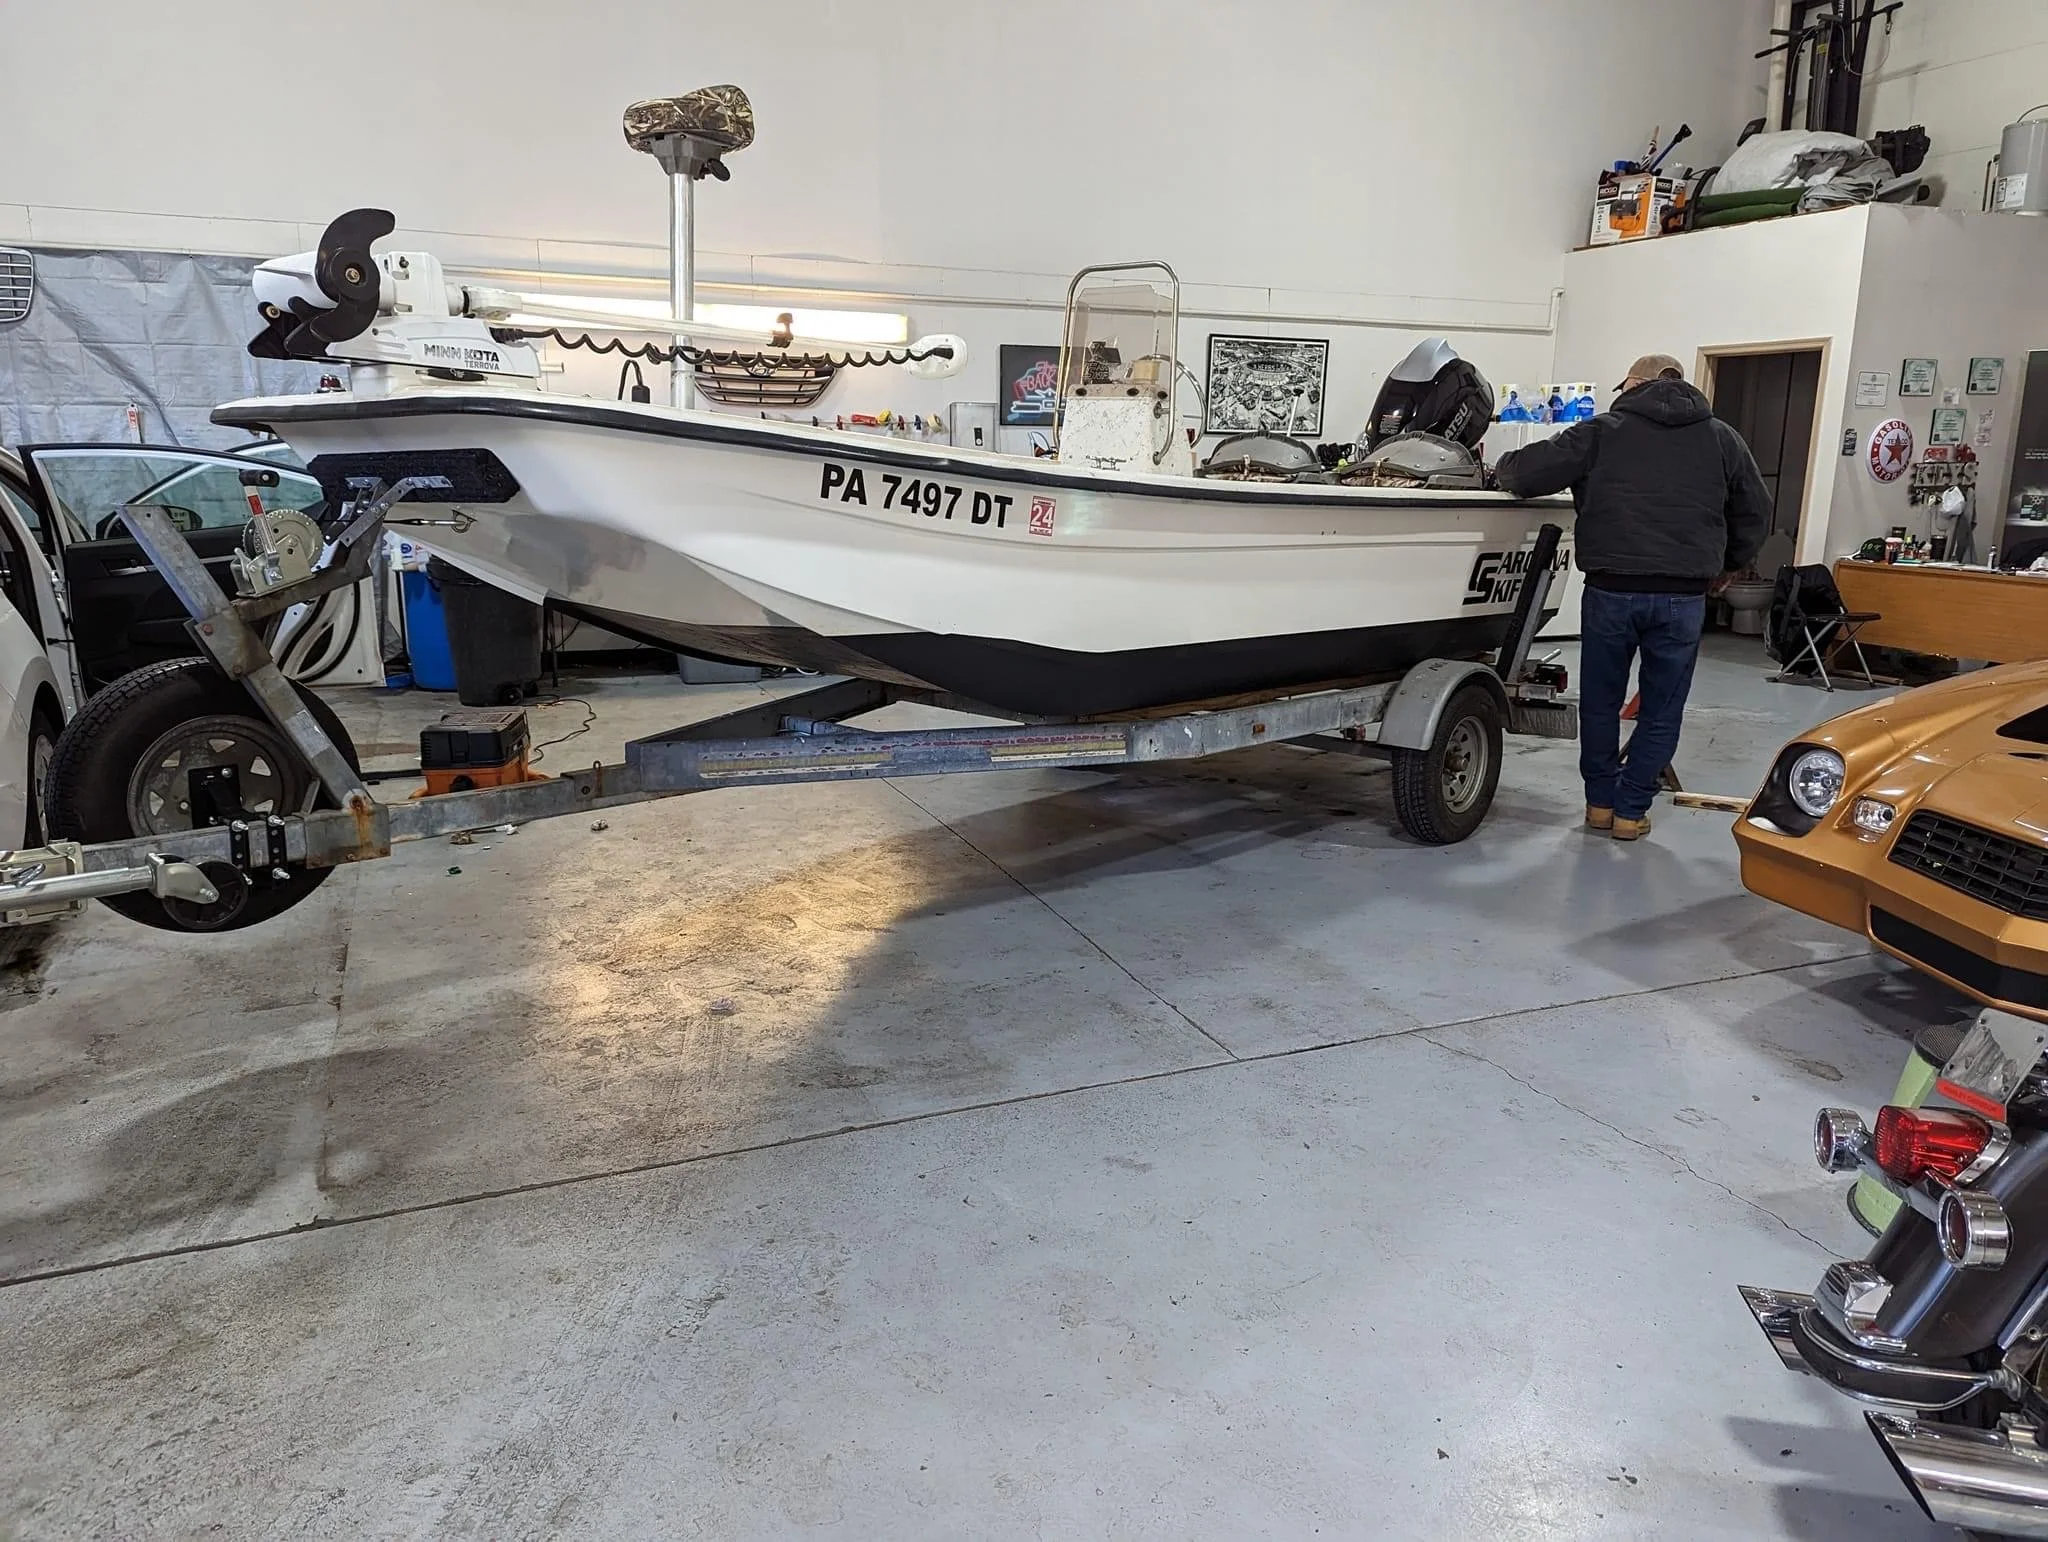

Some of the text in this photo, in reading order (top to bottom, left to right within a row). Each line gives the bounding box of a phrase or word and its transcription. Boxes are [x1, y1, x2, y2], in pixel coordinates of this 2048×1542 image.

[424, 343, 499, 362] MINN KOTA
[464, 360, 500, 370] TERROVA
[1444, 401, 1468, 440] ATSU
[820, 463, 1013, 528] PA 7497 DT
[1030, 505, 1053, 527] 24
[1462, 567, 1522, 605] SKIF
[1468, 549, 1570, 592] CARONA
